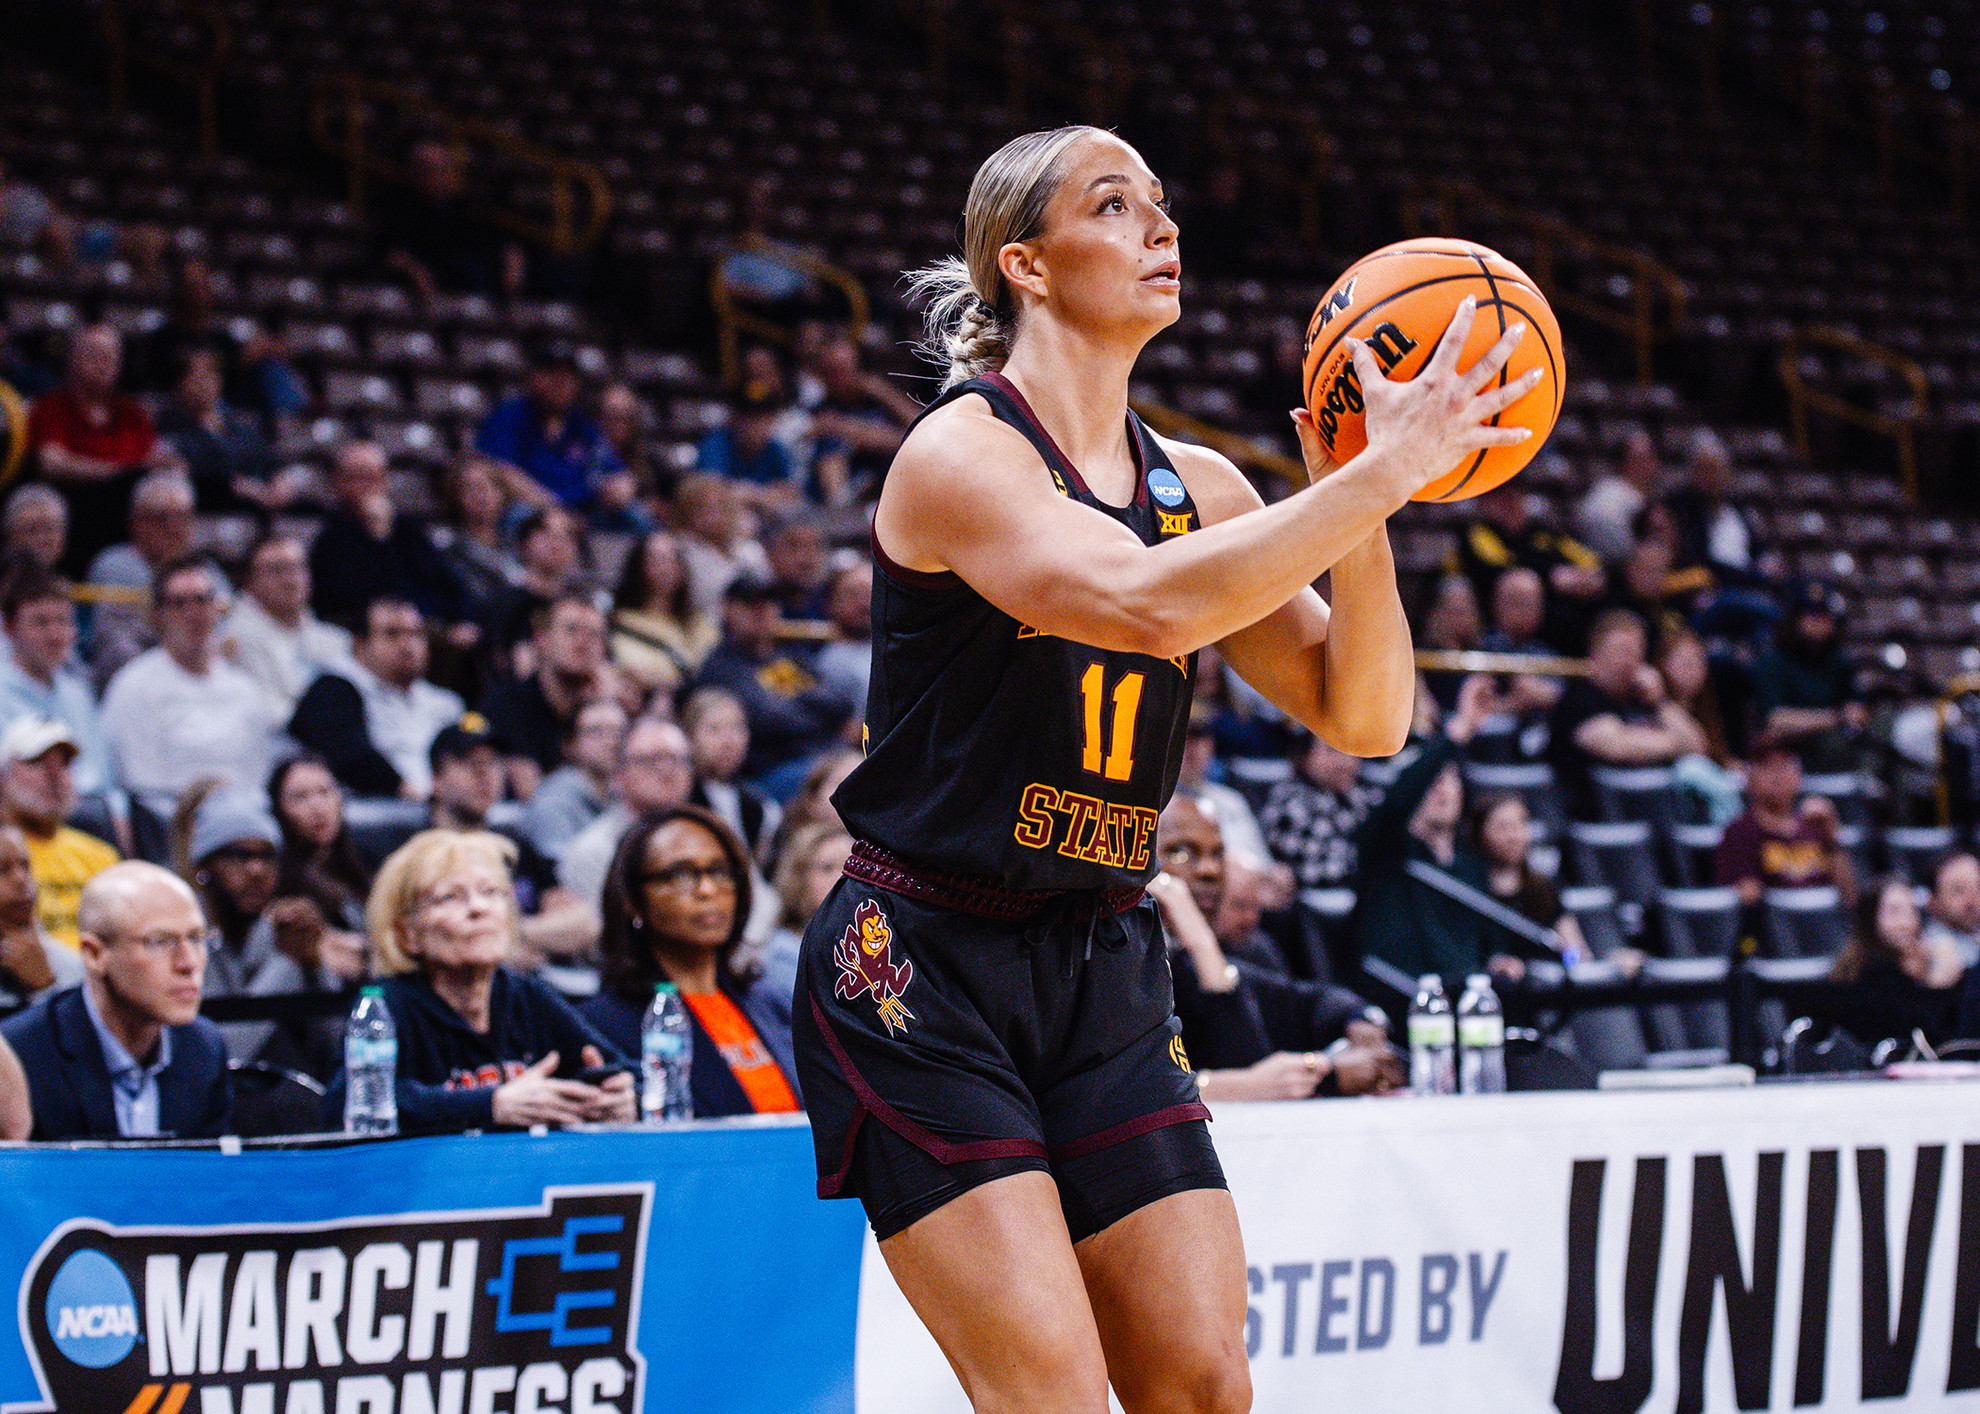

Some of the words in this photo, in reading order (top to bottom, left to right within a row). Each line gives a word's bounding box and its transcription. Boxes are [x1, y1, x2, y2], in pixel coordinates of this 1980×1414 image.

[1330, 353, 1345, 374] EVO
[1154, 484, 1184, 497] NCAA
[1157, 509, 1193, 535] XII
[1080, 660, 1147, 782] 11
[1014, 782, 1159, 870] STATE
[57, 1305, 138, 1339] NCAA
[145, 1238, 479, 1376] MARCH
[1418, 1250, 1510, 1347] BY
